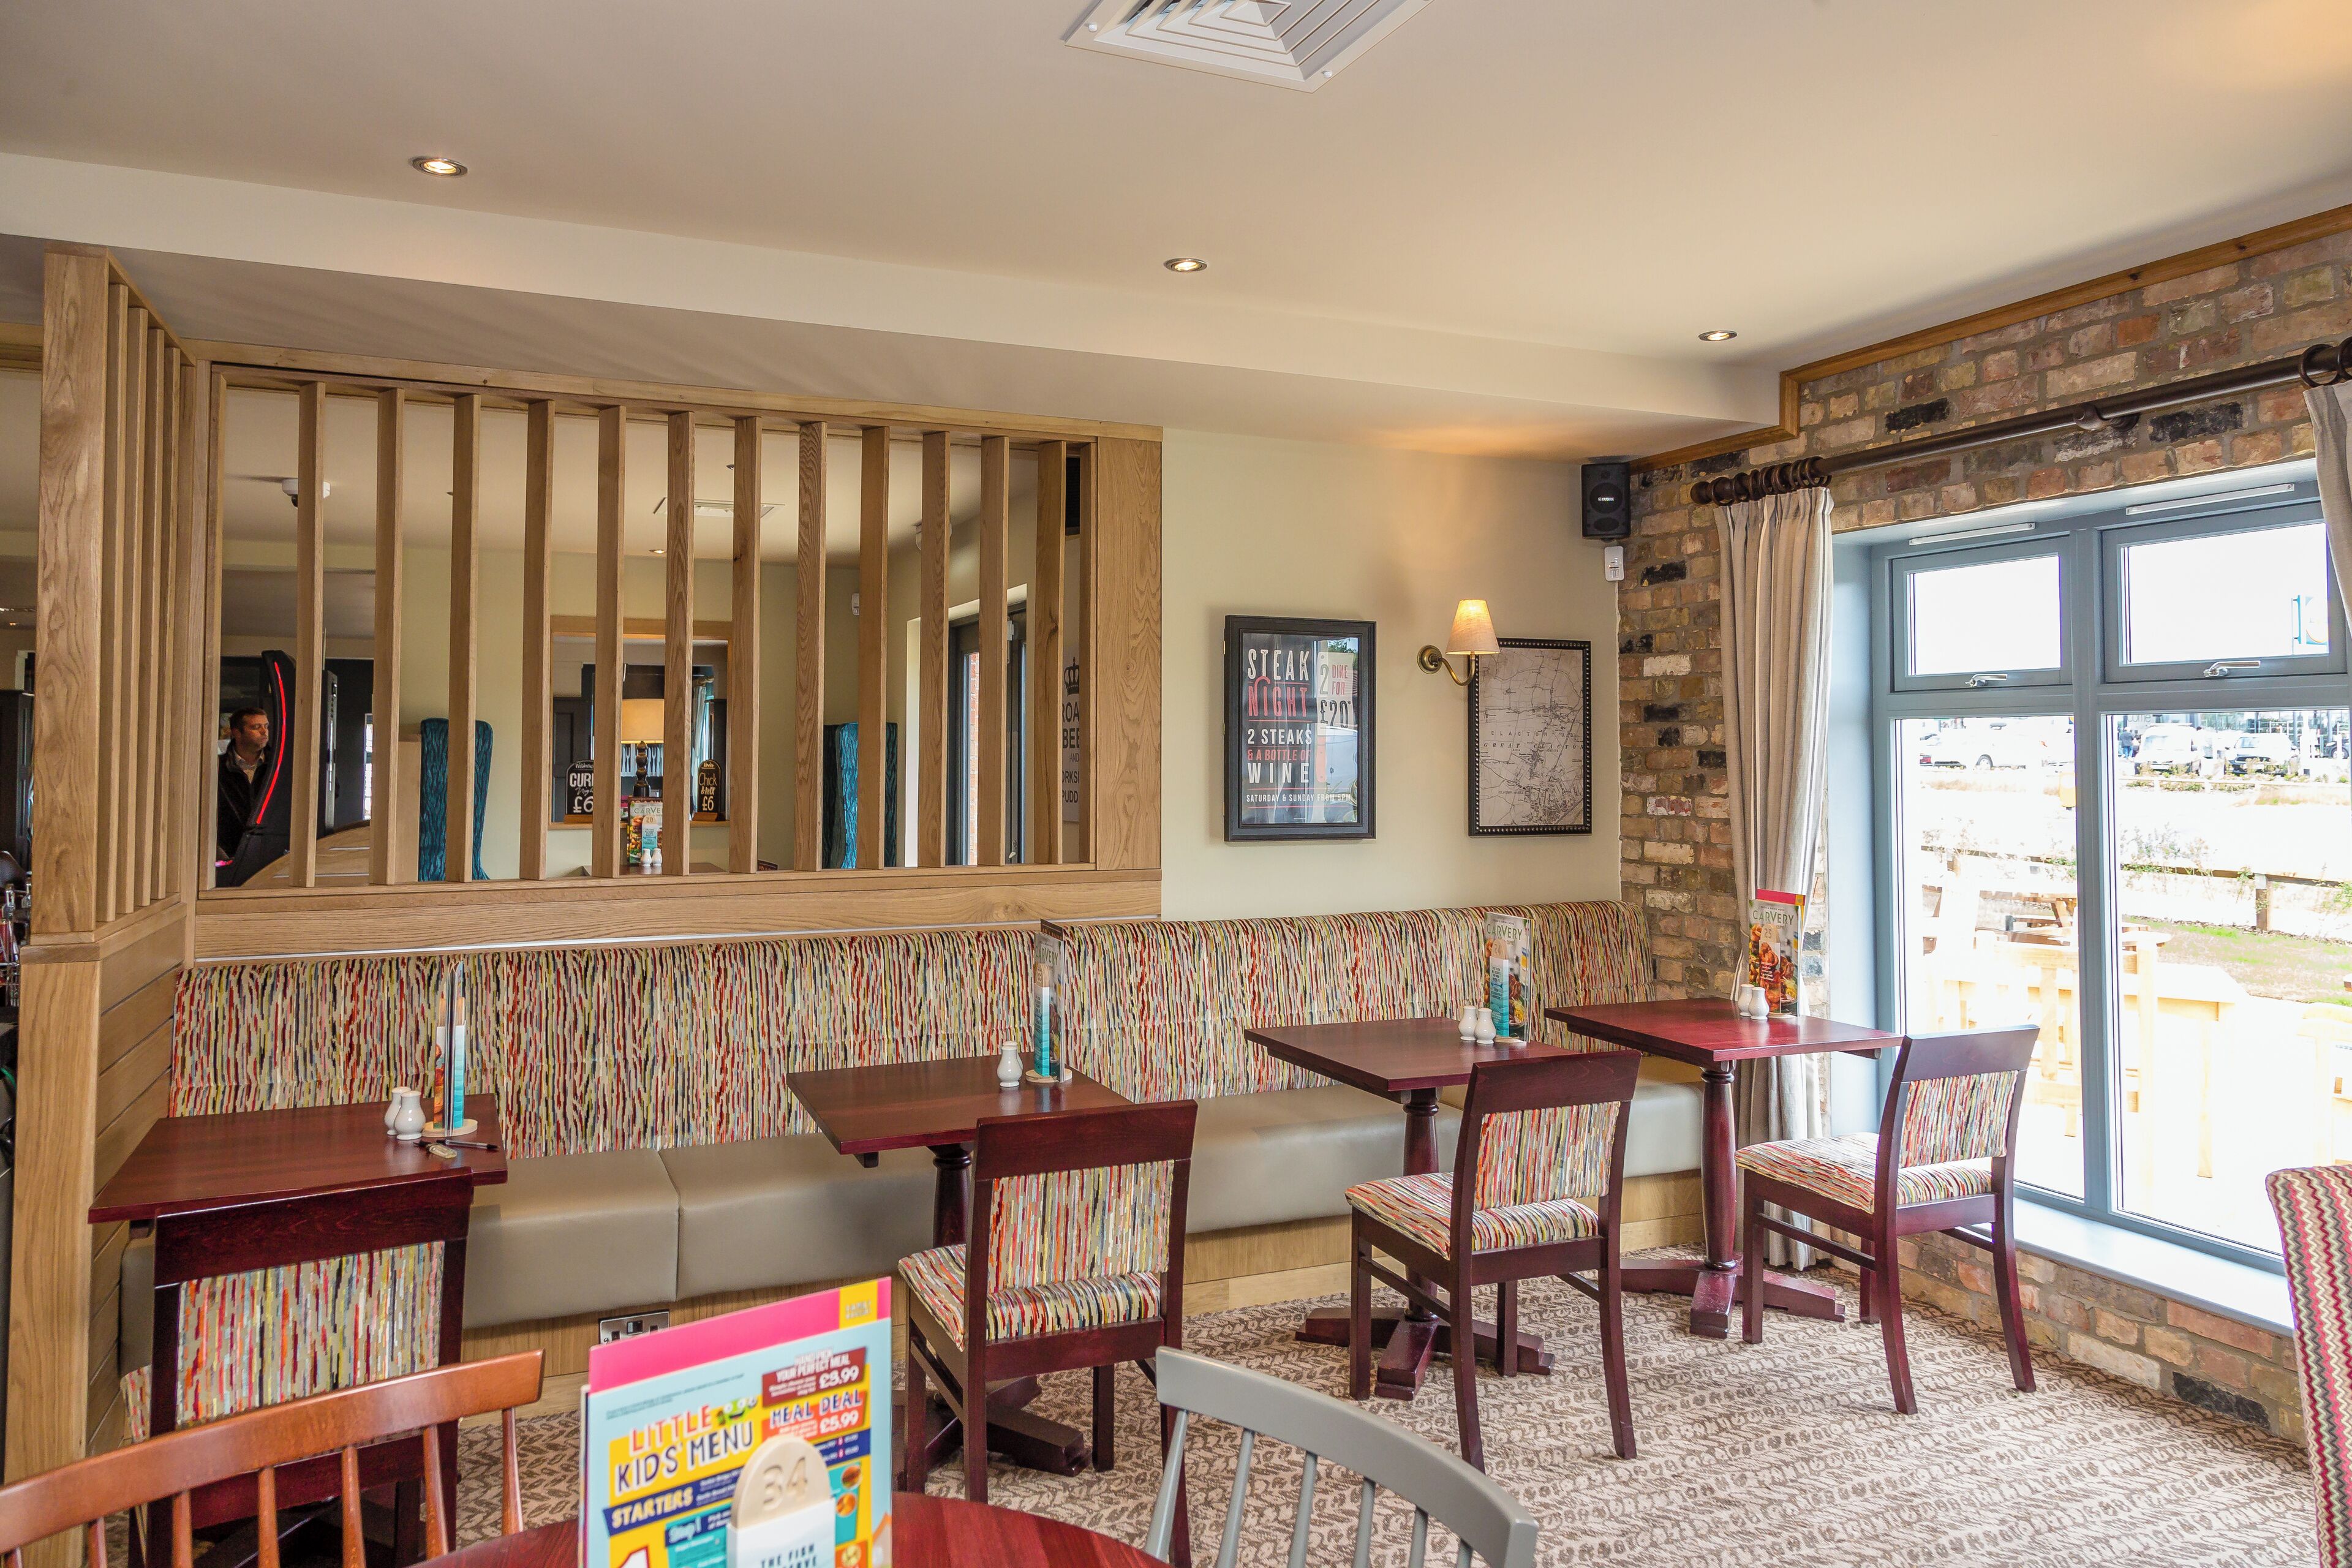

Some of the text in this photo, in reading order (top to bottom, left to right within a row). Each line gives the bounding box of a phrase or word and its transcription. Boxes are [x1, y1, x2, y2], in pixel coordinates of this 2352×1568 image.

[1247, 649, 1310, 681] STEAK
[1319, 664, 1349, 695] 2 DINE
[1332, 681, 1346, 695] FOR
[1248, 676, 1308, 717] NIGHT
[1062, 703, 1079, 722] ROA
[1062, 728, 1079, 749] BEE
[1247, 728, 1313, 745] 2 STEAKS
[1069, 753, 1079, 763] AND
[1247, 749, 1312, 761] & A BOTTLE OF
[570, 772, 594, 787] CUR
[698, 772, 717, 786] Chick
[1247, 763, 1310, 783] WINE
[702, 796, 714, 811] £6
[1062, 790, 1079, 803] PUDD
[1246, 794, 1280, 802] SATURDAY
[1289, 794, 1315, 802] SUNDAY
[1752, 910, 1794, 925] CARVERY
[1487, 924, 1523, 941] CARVERY
[771, 1389, 862, 1428] MEAL DEAL
[631, 1403, 712, 1453] LITTLE
[690, 1421, 753, 1466] MENU
[763, 1456, 809, 1507] 34
[611, 1487, 694, 1529] STARTERS
